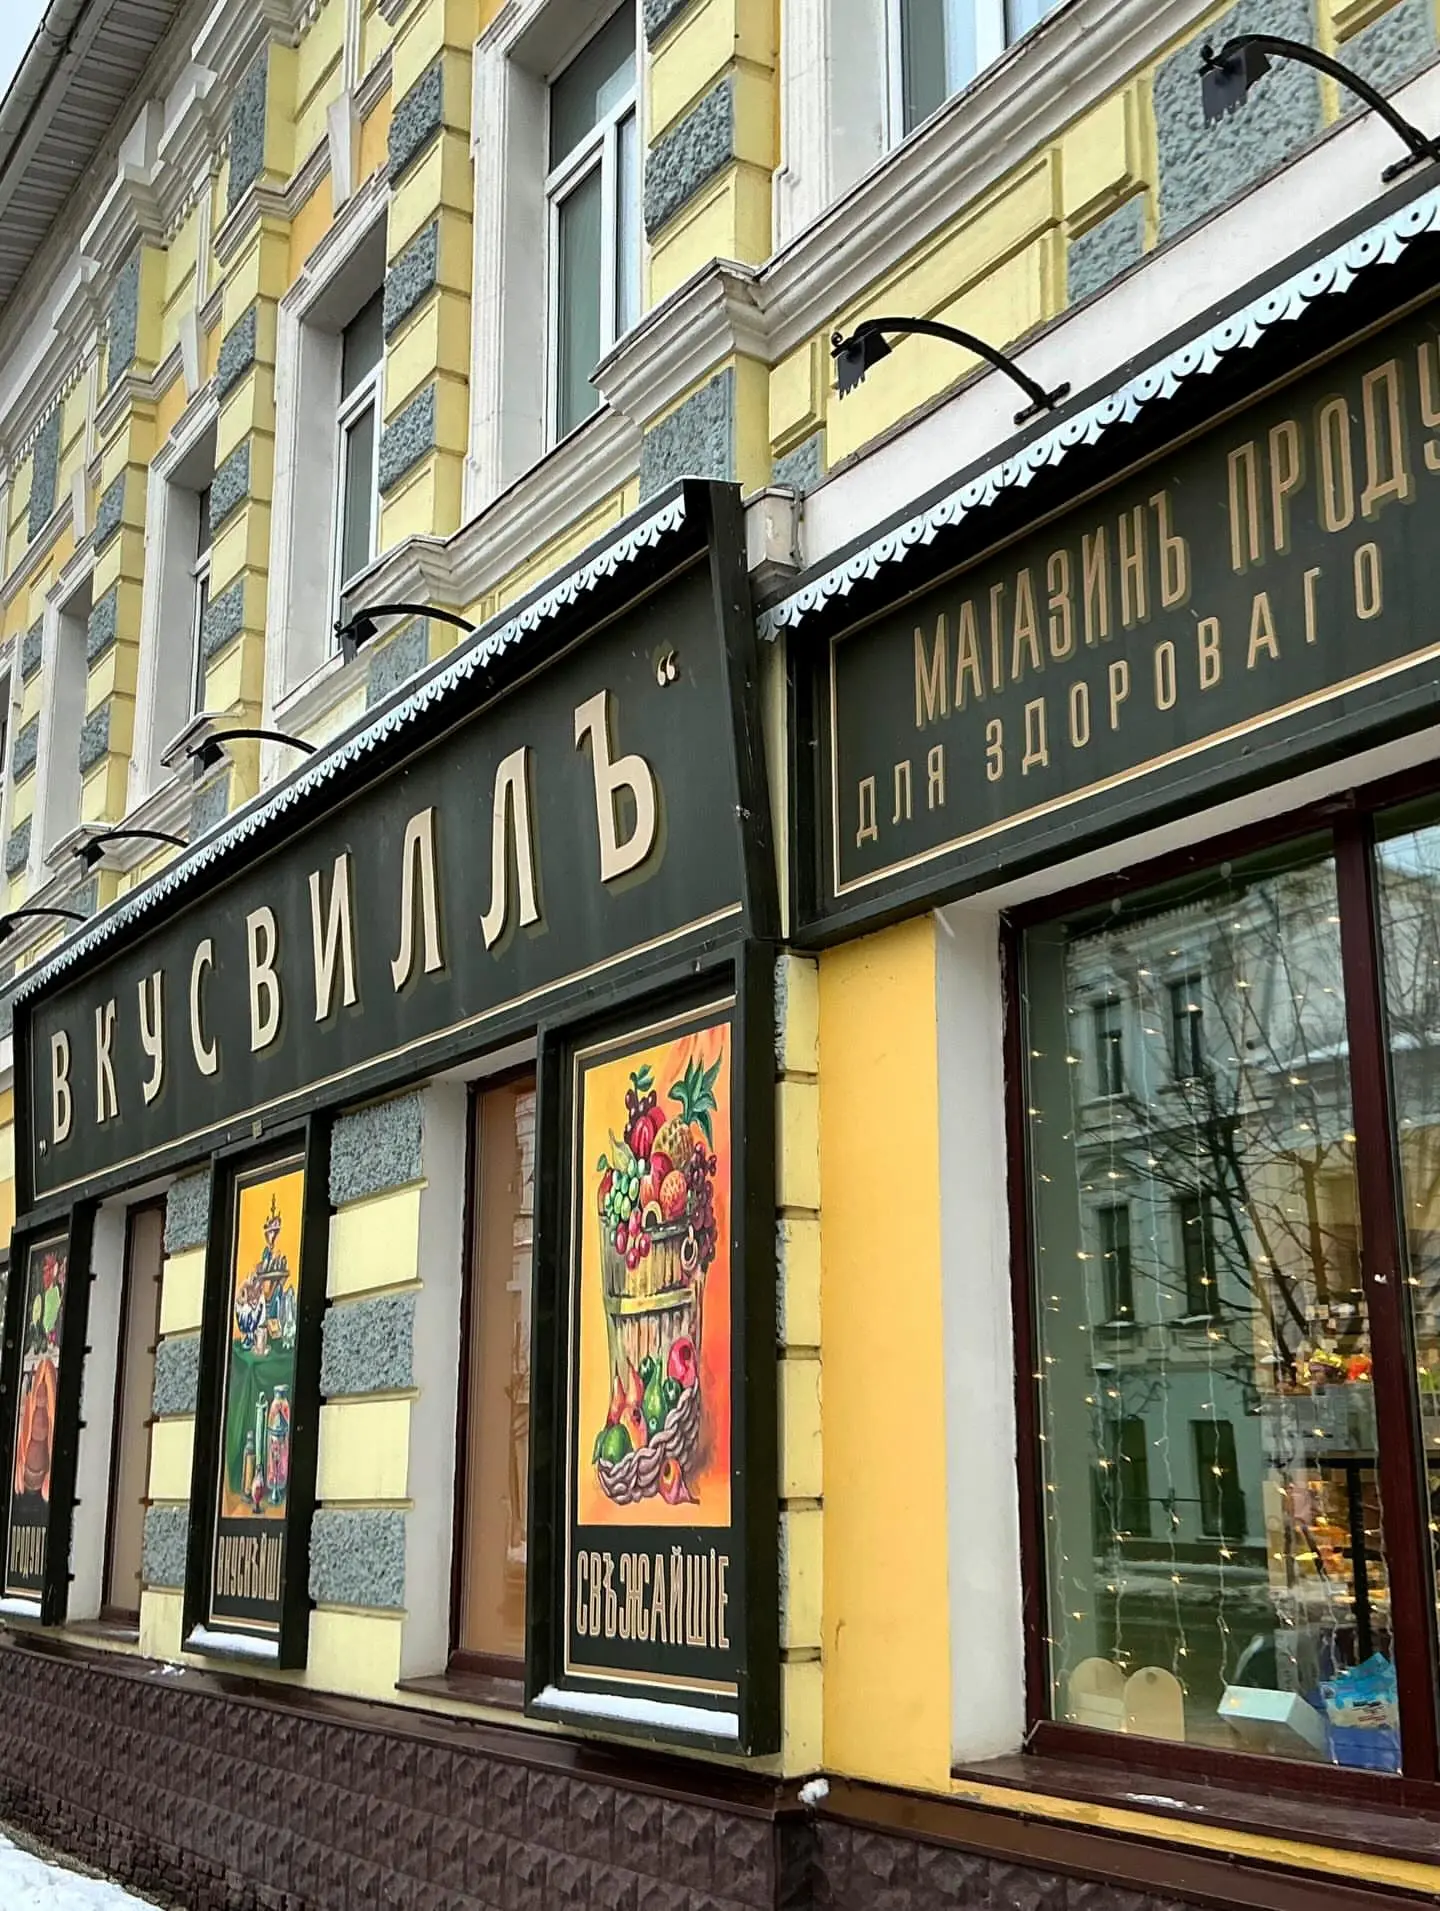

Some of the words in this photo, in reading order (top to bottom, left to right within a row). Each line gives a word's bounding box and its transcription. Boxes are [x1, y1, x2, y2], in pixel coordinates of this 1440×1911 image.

[856, 744, 945, 849] ДЛЯ
[985, 542, 1382, 775] ЗДОРОВАГО
[913, 489, 1188, 728] МАГАЗИНЪ
